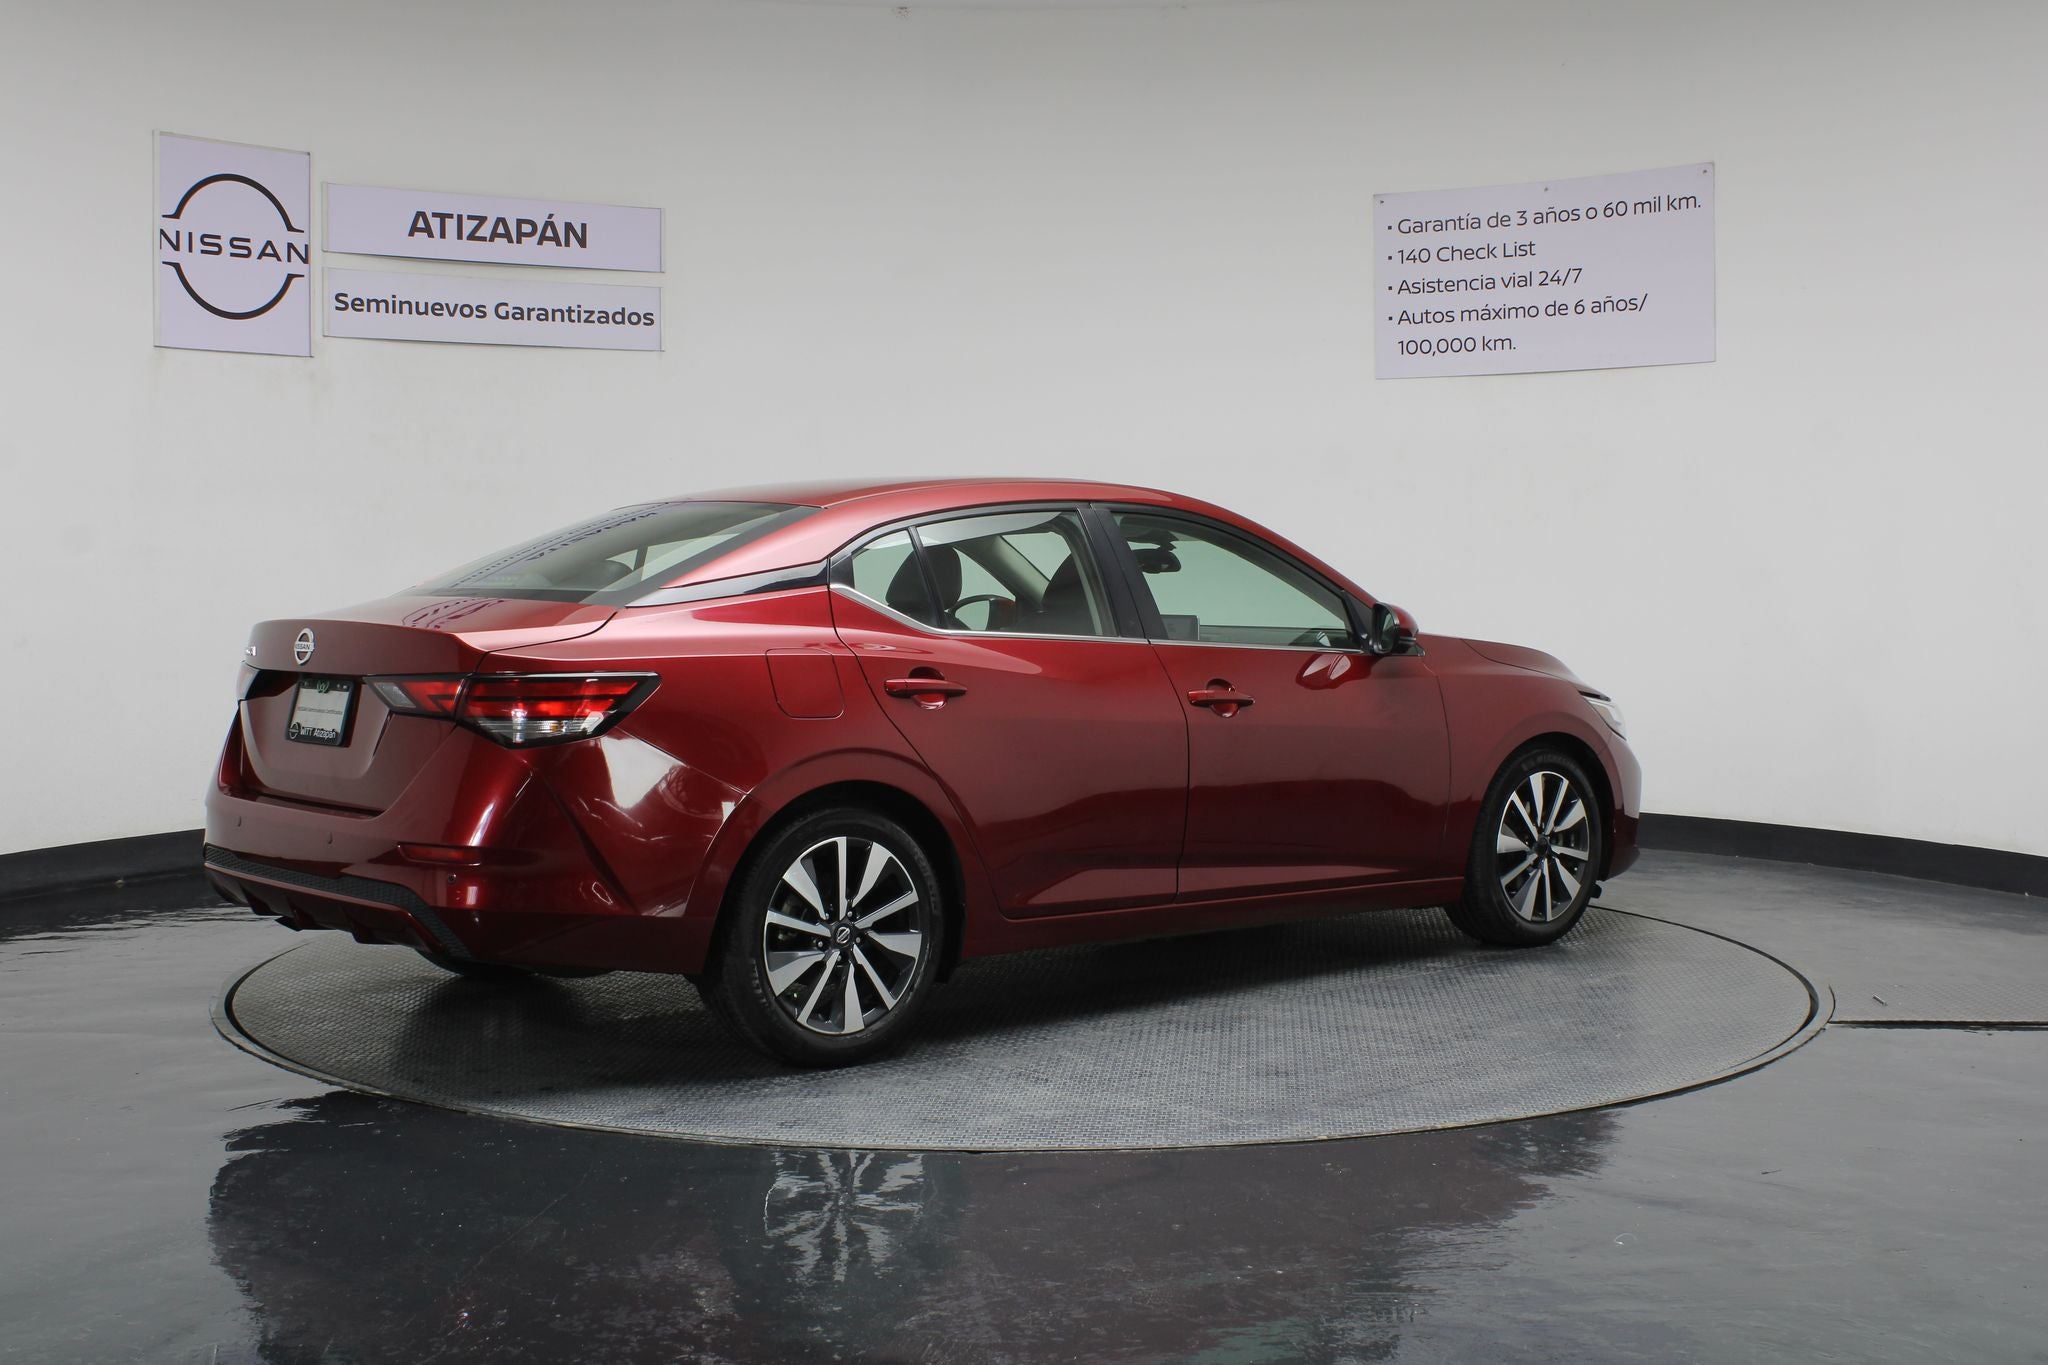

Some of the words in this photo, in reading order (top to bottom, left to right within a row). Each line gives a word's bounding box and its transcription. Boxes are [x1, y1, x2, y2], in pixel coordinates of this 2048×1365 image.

[408, 211, 588, 249] ATIZAPÁN
[1398, 213, 1480, 234] Garantía
[1487, 212, 1510, 228] de
[1517, 211, 1527, 225] 3
[1534, 207, 1580, 224] años
[1586, 207, 1597, 219] o
[1603, 201, 1627, 217] 60
[1634, 196, 1660, 214] mil
[1667, 195, 1701, 211] km.
[160, 228, 309, 265] NISSAN
[1398, 248, 1430, 264] 140
[1437, 243, 1497, 262] Check
[1504, 241, 1536, 257] List
[1398, 275, 1495, 294] Asistencia
[1501, 271, 1532, 288] vial
[1539, 268, 1582, 286] 24/7
[335, 293, 487, 318] Seminuevos
[495, 302, 654, 326] Garantizados
[1398, 310, 1454, 325] Autos
[1461, 304, 1539, 321] máximo
[1545, 301, 1568, 316] de
[1574, 299, 1585, 314] 6
[1591, 294, 1648, 313] años/
[1398, 337, 1476, 356] 100,000
[1483, 336, 1516, 351] km.
